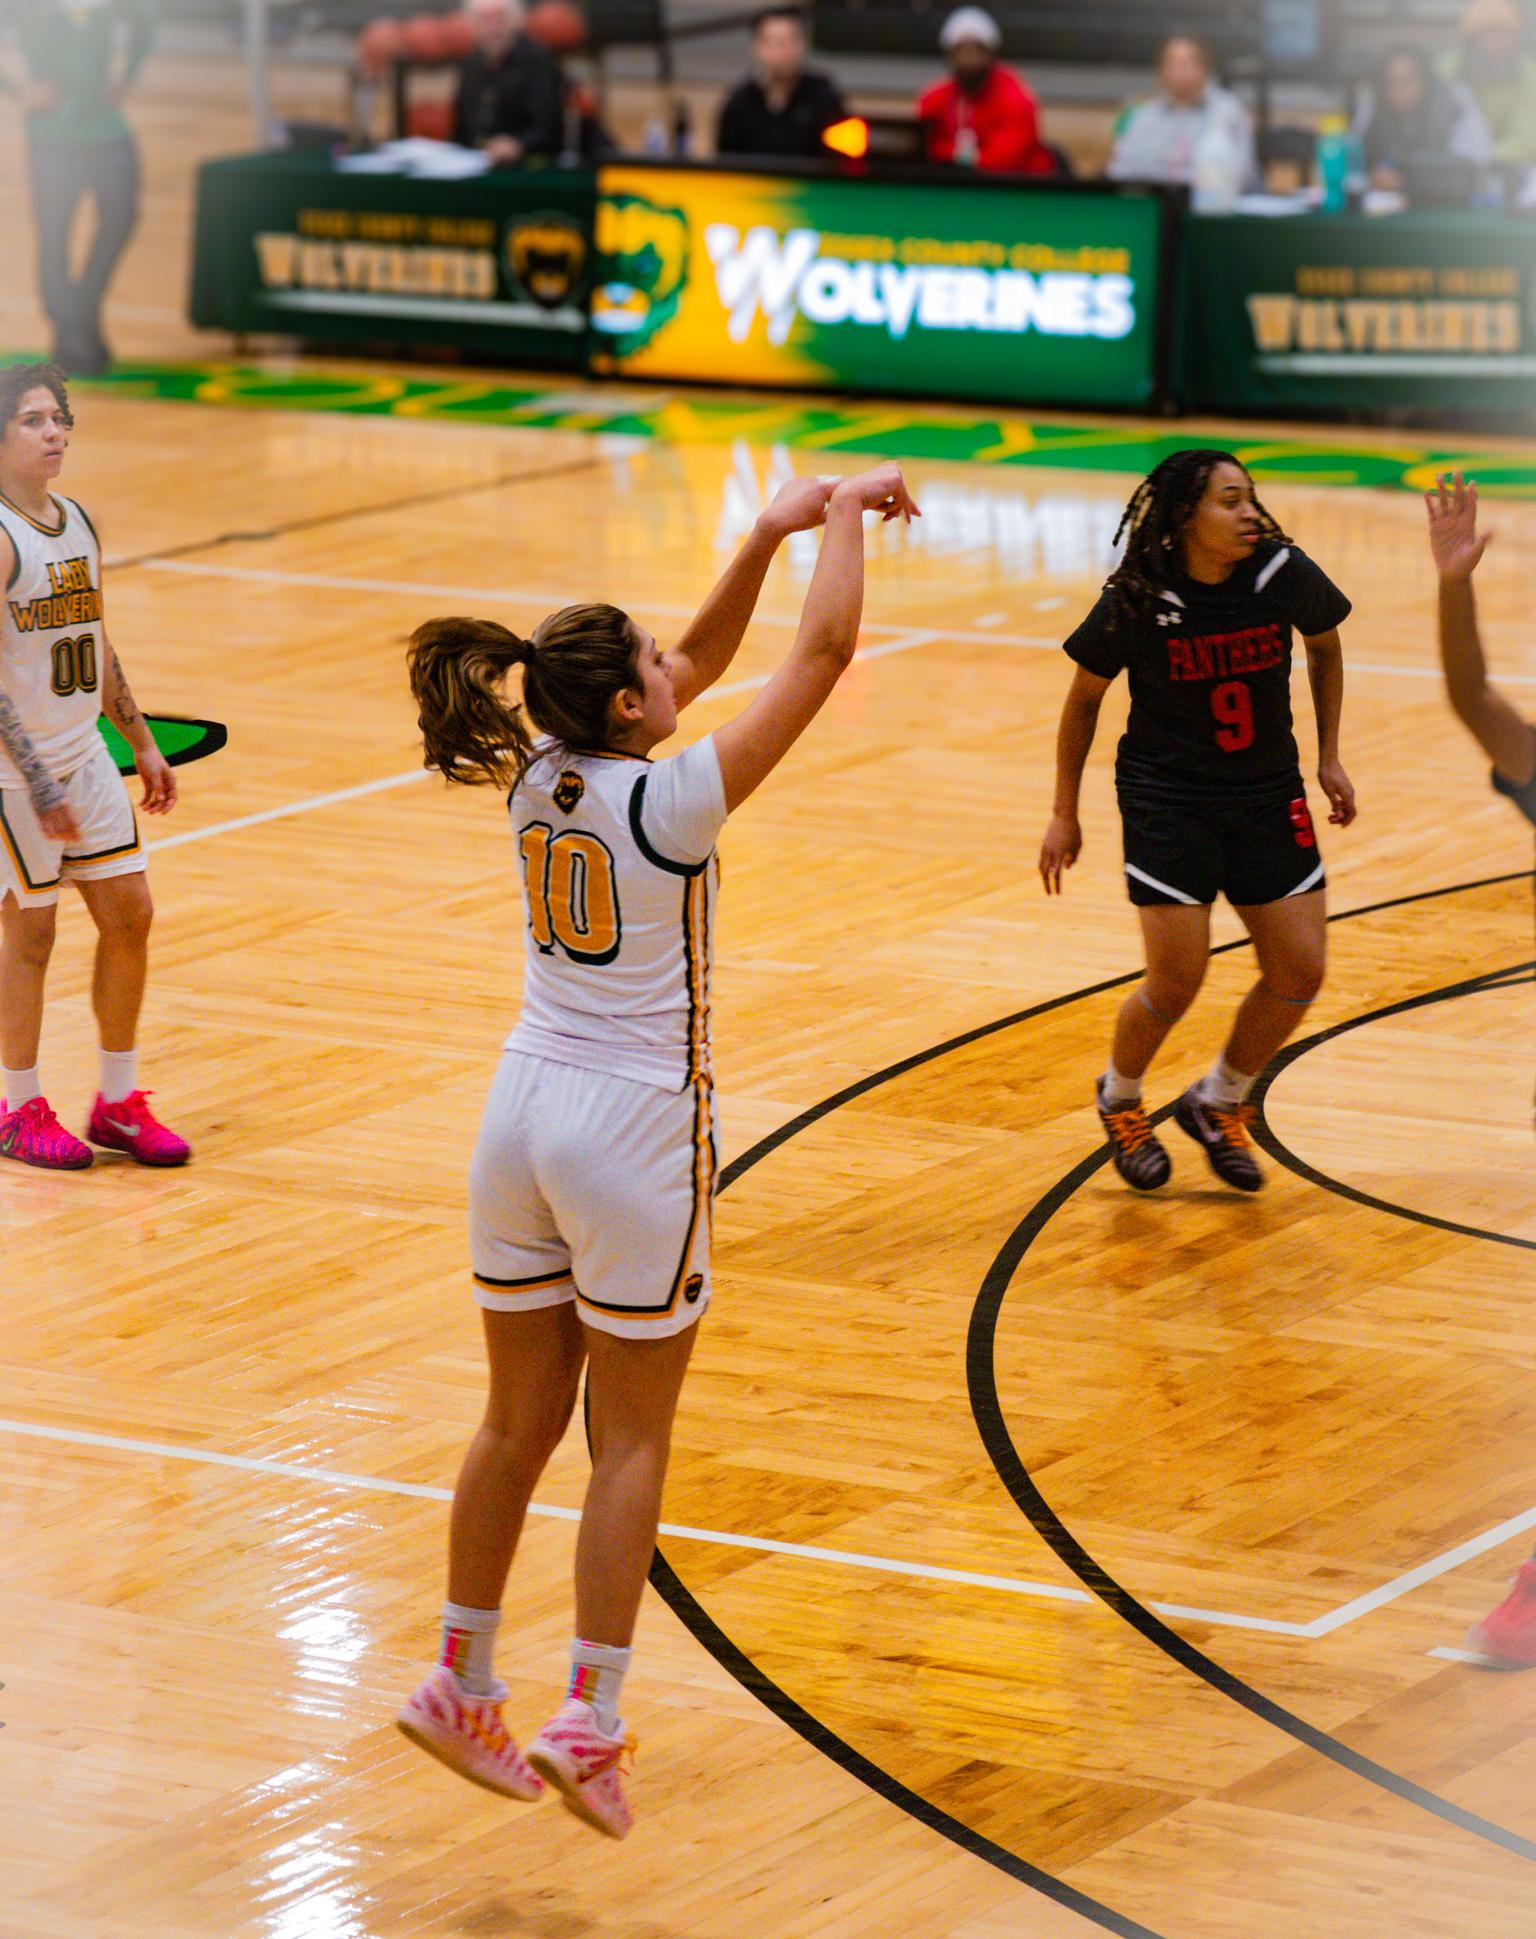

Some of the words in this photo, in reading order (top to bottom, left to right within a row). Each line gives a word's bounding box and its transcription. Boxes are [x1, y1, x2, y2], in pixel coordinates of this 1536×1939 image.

[704, 223, 1136, 345] WOLVERINES
[46, 556, 93, 596] LADY
[51, 634, 97, 697] 00
[1166, 623, 1285, 682] PANTHERS
[1210, 681, 1256, 753] 9
[518, 820, 622, 966] 10
